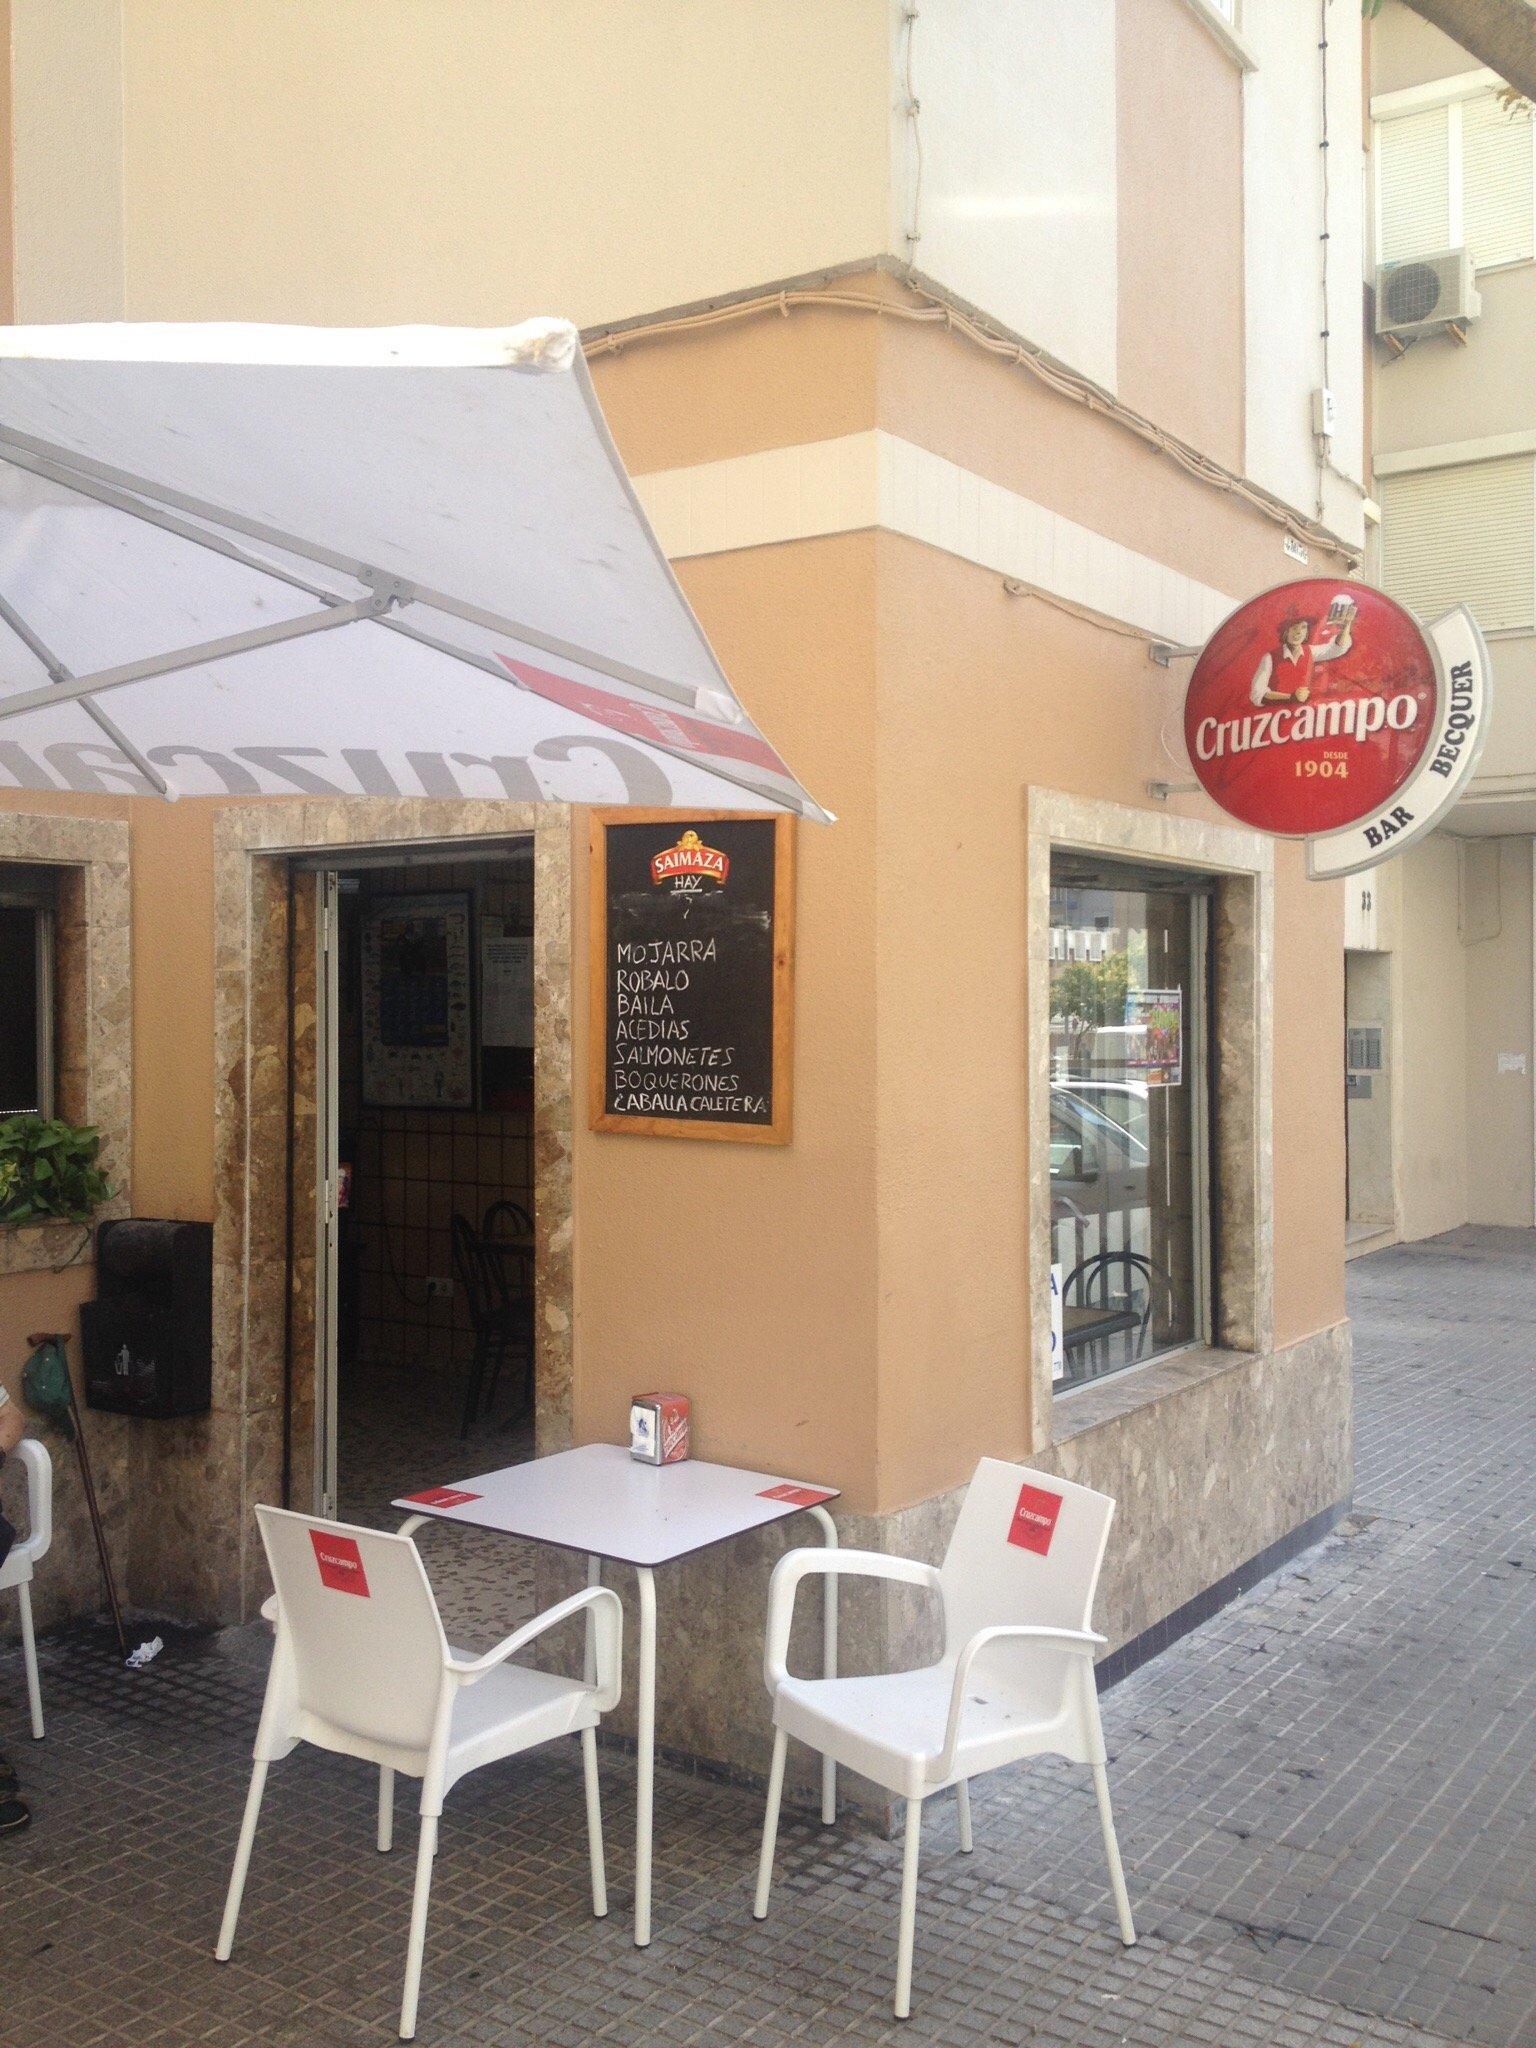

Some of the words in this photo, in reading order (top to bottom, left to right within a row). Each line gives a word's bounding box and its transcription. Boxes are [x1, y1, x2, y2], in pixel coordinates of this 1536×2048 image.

[1195, 694, 1419, 762] Cruzcampo
[1323, 750, 1349, 760] DESDE
[1362, 806, 1415, 849] BAR
[1429, 660, 1476, 778] BECQUER
[1294, 760, 1350, 780] 1904
[654, 851, 724, 874] SAIMAZA
[675, 875, 702, 890] HAY
[617, 937, 717, 966] MOJARRA
[617, 969, 690, 993] ROBALO
[617, 993, 675, 1018] BAILA
[615, 1019, 691, 1041] ACEDIAS
[613, 1042, 735, 1067] SALMONETES
[614, 1069, 740, 1092] BOQUERONES
